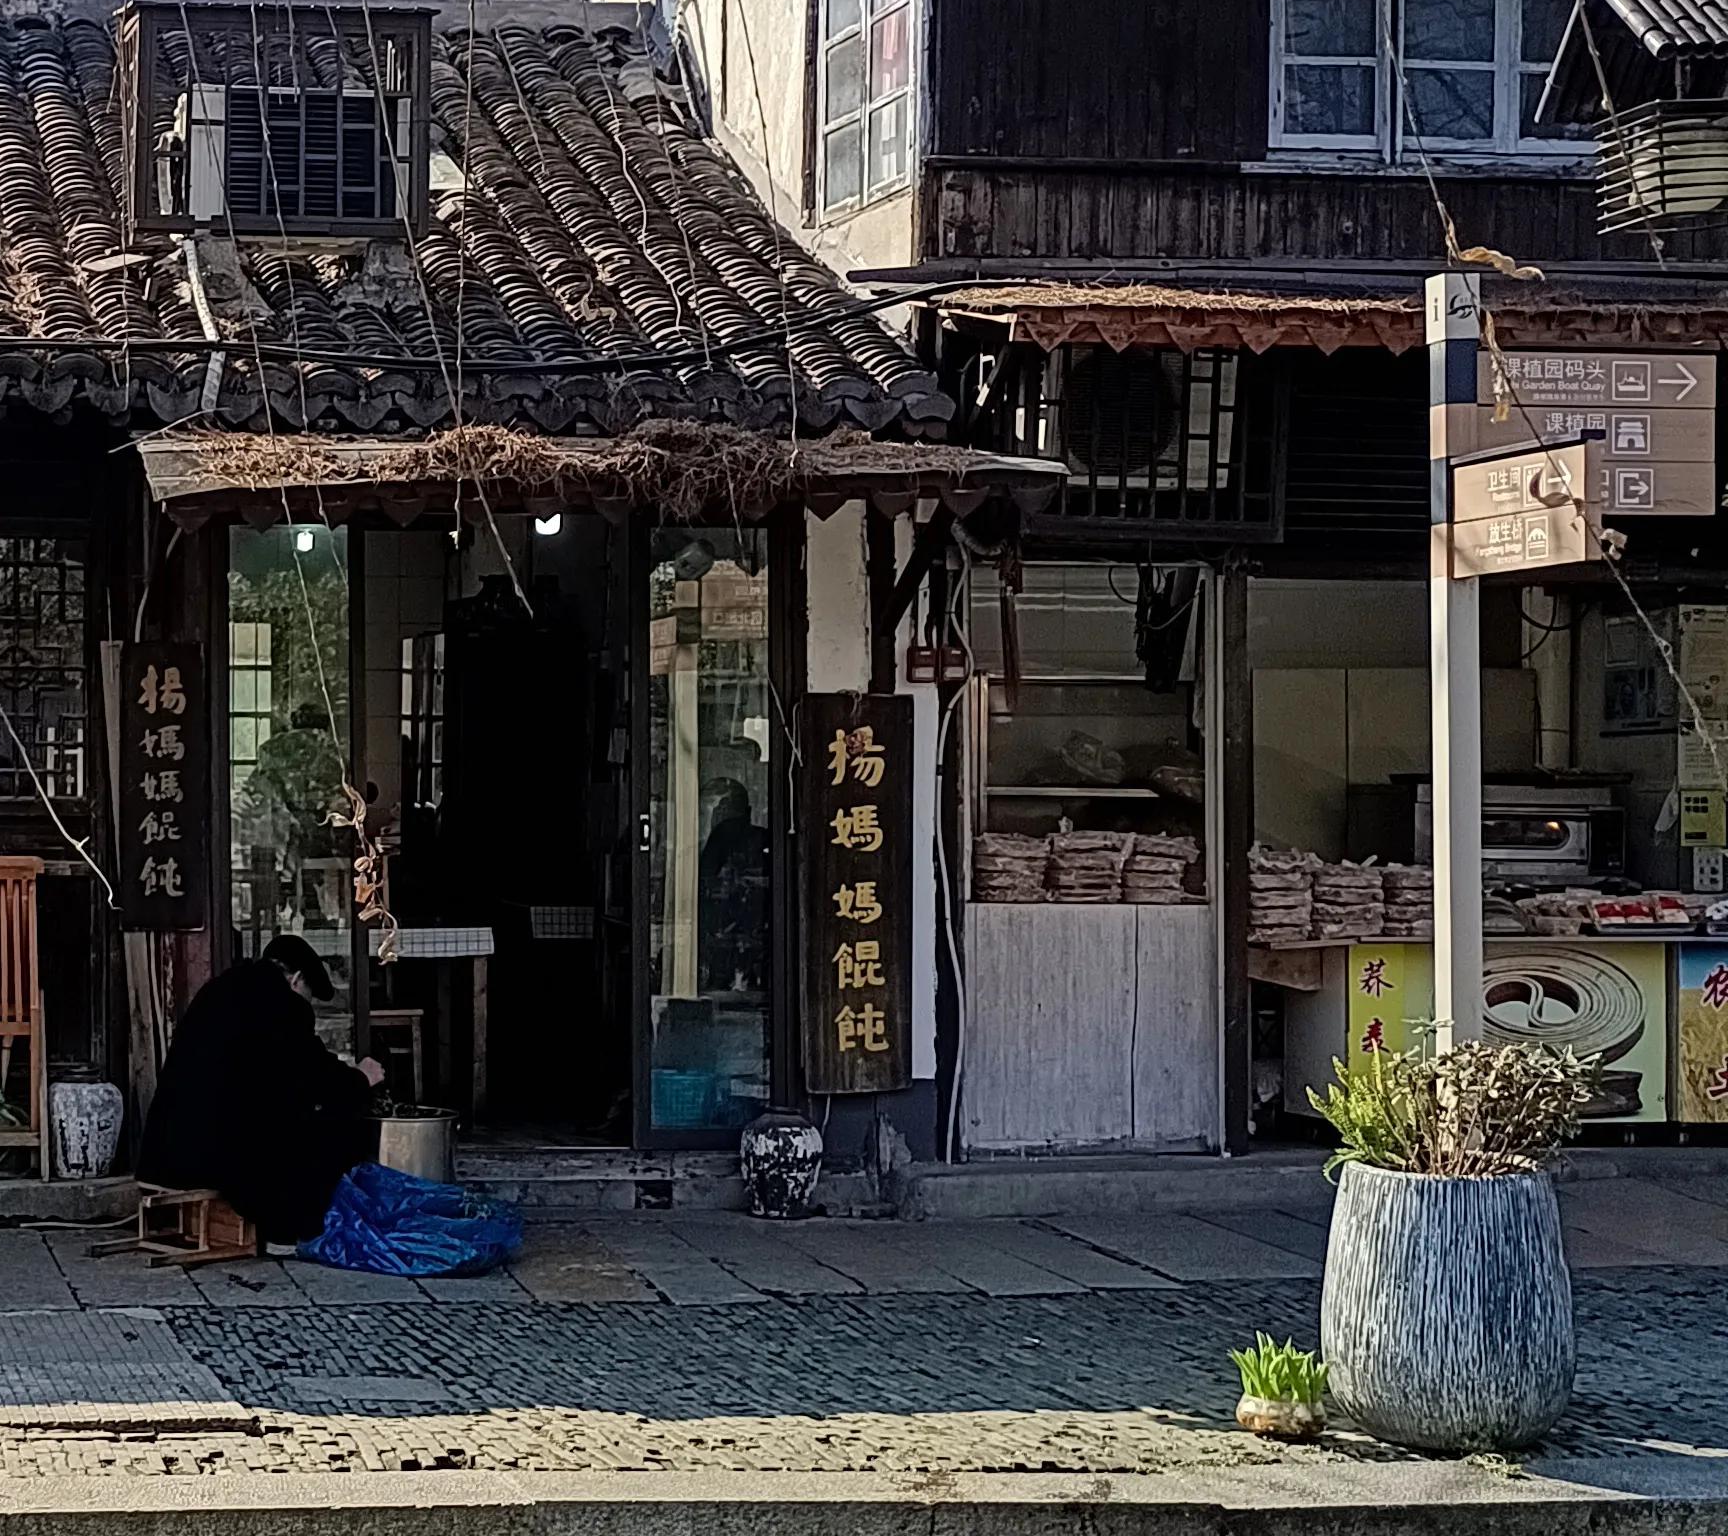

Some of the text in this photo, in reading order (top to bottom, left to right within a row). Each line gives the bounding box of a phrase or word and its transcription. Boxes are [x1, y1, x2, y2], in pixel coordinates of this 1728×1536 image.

[1503, 358, 1606, 380] 课植园码头
[1522, 380, 1555, 391] Garden
[1558, 380, 1579, 390] Boat
[1581, 381, 1605, 393] Quay
[1545, 413, 1606, 433] 课植园
[1487, 466, 1521, 492] 卫生间
